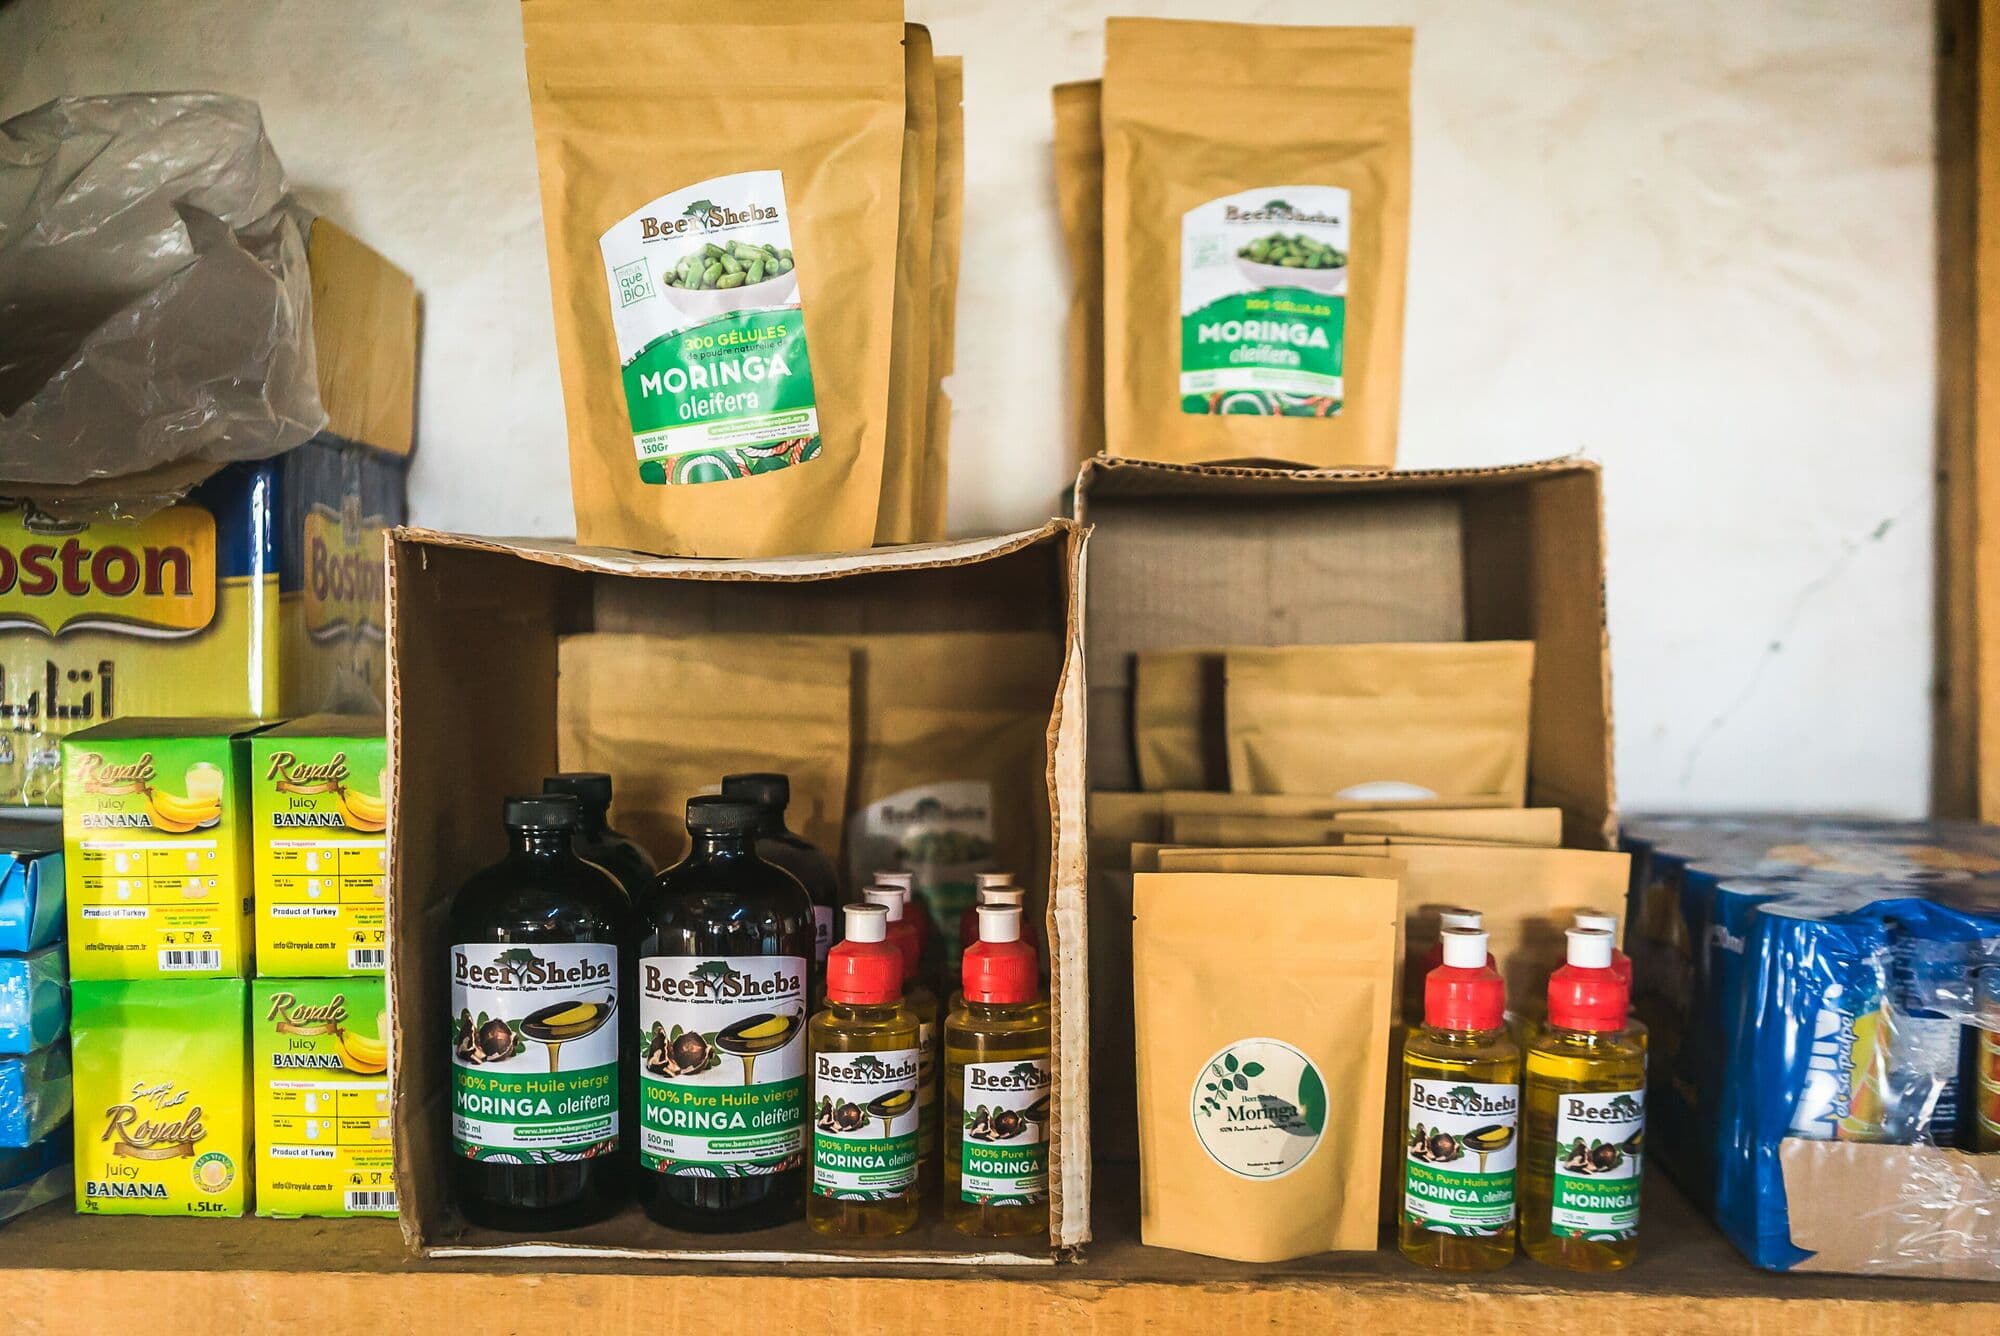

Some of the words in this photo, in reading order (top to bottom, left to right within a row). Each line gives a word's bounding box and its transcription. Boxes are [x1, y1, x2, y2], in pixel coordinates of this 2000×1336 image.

[642, 216, 700, 239] Beer
[708, 203, 779, 228] Sheba
[621, 272, 643, 288] que
[684, 336, 714, 351] 300
[717, 325, 787, 347] GÉLULES
[1197, 318, 1330, 349] MORINGA
[640, 353, 792, 398] MORINGA
[679, 391, 759, 420] oleifera
[643, 442, 668, 454] 150Gr
[78, 752, 155, 783] Royale
[267, 751, 348, 783] Royale
[83, 813, 152, 827] BANANA
[273, 813, 344, 827] BANANA
[83, 908, 111, 917] Product
[113, 908, 121, 917] of
[122, 908, 146, 918] Turkey
[312, 908, 336, 916] Turkey
[455, 952, 517, 984] Beer
[526, 957, 611, 985] Sheba
[645, 965, 708, 997] Beer
[723, 971, 801, 997] Sheba
[266, 991, 348, 1025] Royale
[1834, 1007, 1857, 1070] pulpe!
[272, 1053, 343, 1068] BANANA
[818, 1057, 862, 1080] Beer
[489, 1079, 522, 1093] Pure
[526, 1079, 566, 1094] Huile
[569, 1074, 610, 1090] vierge
[970, 1067, 1021, 1088] Beer
[1836, 1072, 1851, 1094] sa
[457, 1090, 553, 1117] MORINGA
[558, 1093, 610, 1115] oleifera
[647, 1086, 680, 1104] 100%
[683, 1092, 717, 1106] Pure
[721, 1092, 759, 1106] Huile
[763, 1087, 799, 1103] vierge
[1413, 1083, 1458, 1110] Beer
[646, 1103, 747, 1129] MORINGA
[752, 1107, 800, 1128] oleifera
[1227, 1104, 1299, 1122] Moringa
[1567, 1098, 1619, 1119] Beer
[101, 1103, 207, 1149] Royale
[472, 1124, 481, 1133] ml
[647, 1132, 662, 1145] 500
[663, 1138, 674, 1147] ml
[818, 1138, 842, 1151] 100%
[844, 1143, 867, 1153] Pure
[869, 1143, 894, 1153] Huile
[272, 1148, 299, 1156] Product
[301, 1148, 308, 1156] of
[310, 1148, 334, 1158] Turkey
[817, 1150, 886, 1168] MORINGA
[970, 1148, 999, 1159] 100%
[1001, 1150, 1024, 1159] Pure
[969, 1158, 1040, 1174] MORINGA
[1410, 1166, 1434, 1181] 100%
[1436, 1174, 1460, 1186] Pure
[1463, 1178, 1489, 1187] Huile
[86, 1180, 168, 1198] BANANA
[1409, 1177, 1480, 1203] MORINGA
[1564, 1180, 1596, 1192] 100%
[1562, 1191, 1633, 1209] MORINGA
